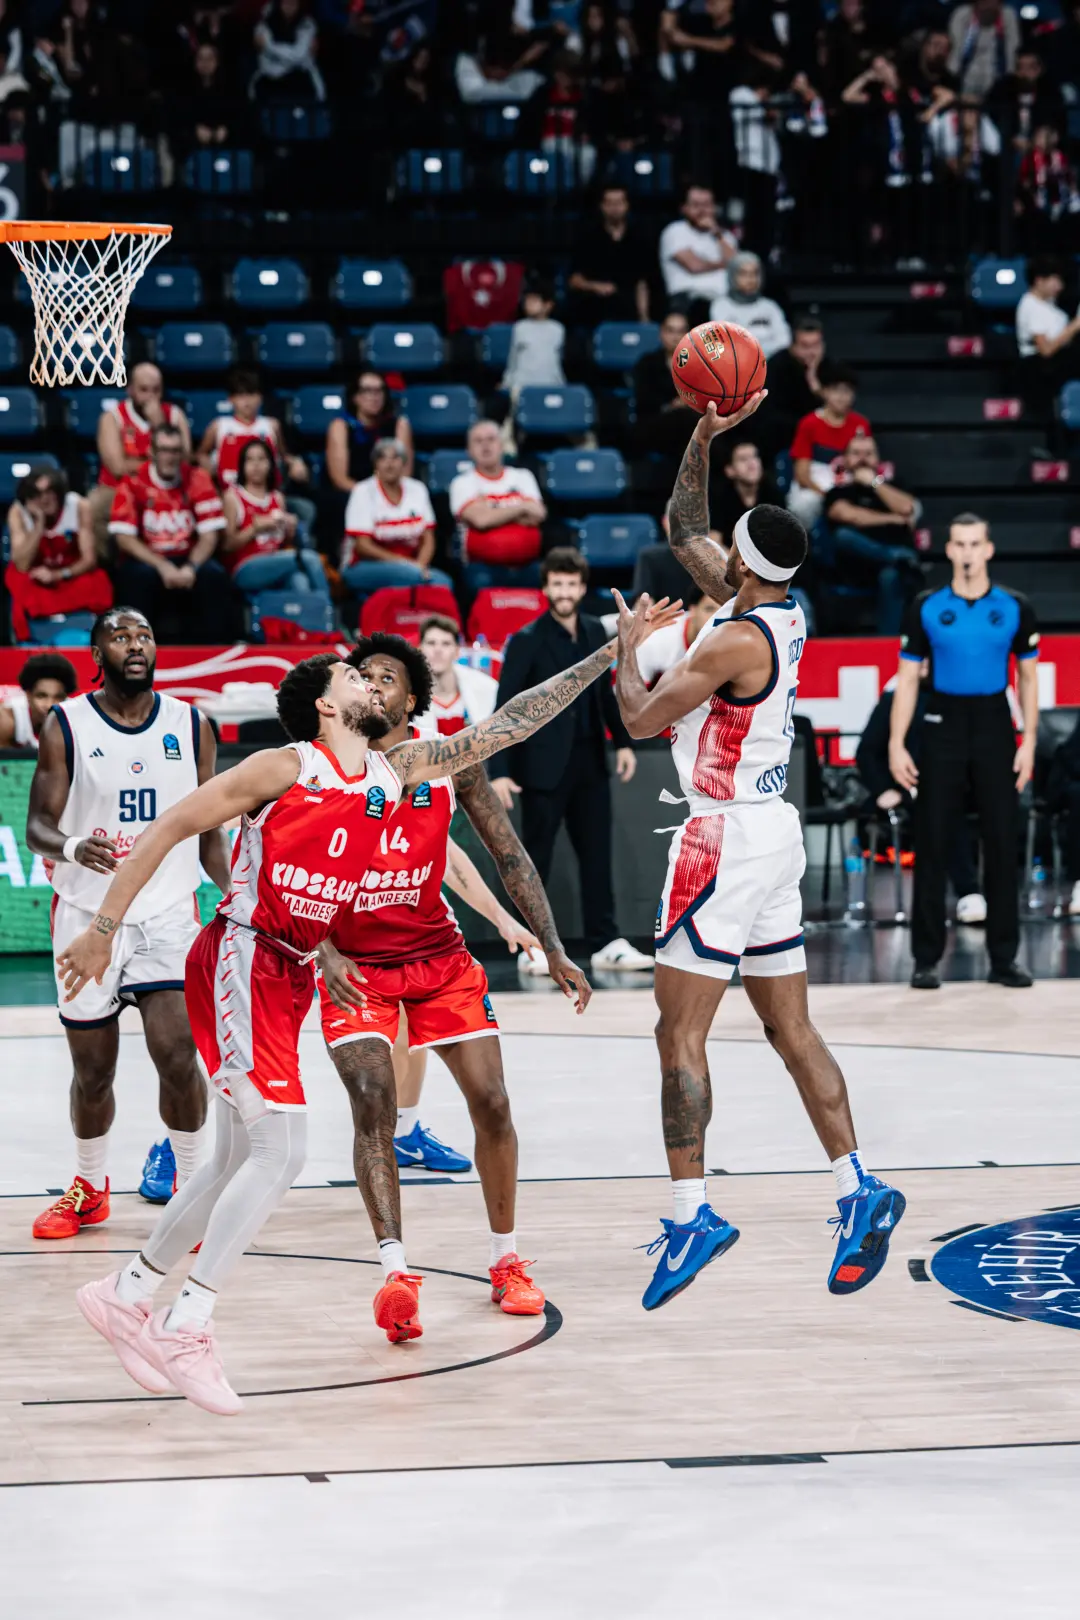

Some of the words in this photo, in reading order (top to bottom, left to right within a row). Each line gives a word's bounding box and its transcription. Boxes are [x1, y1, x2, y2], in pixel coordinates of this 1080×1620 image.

[119, 788, 157, 822] 50
[327, 827, 348, 858] 0
[380, 826, 410, 855] 14
[358, 893, 418, 909] MANRESA
